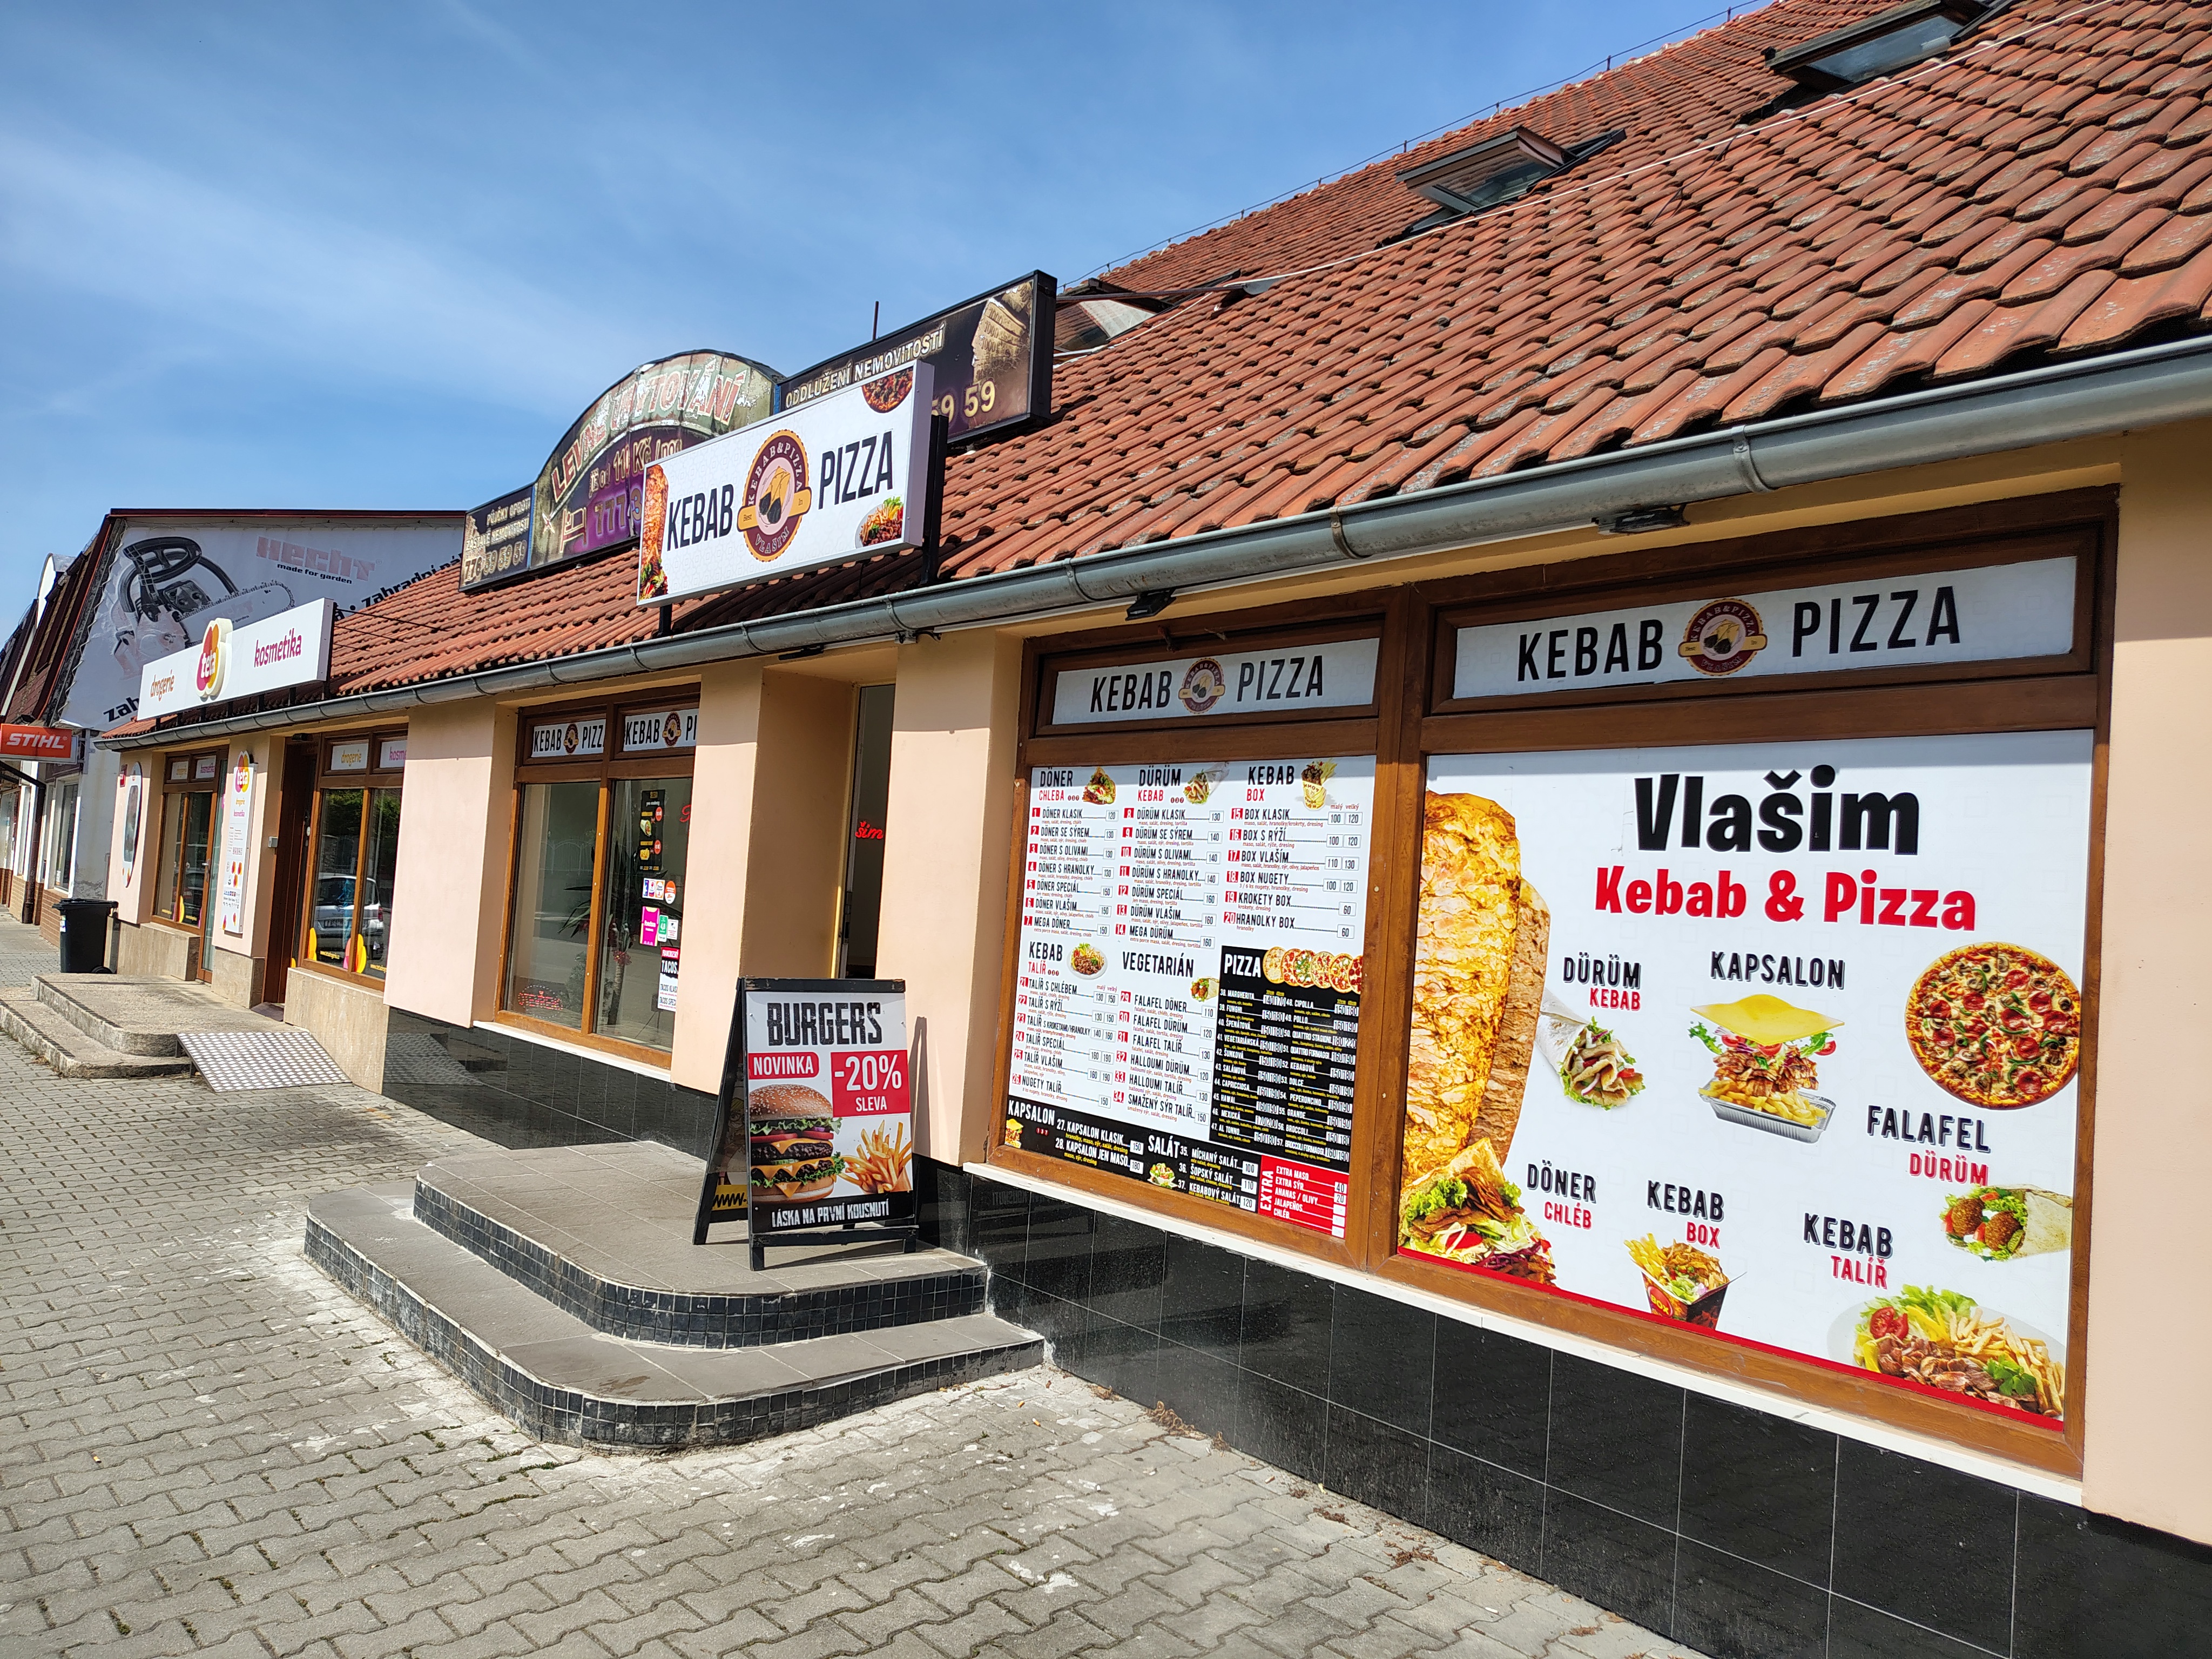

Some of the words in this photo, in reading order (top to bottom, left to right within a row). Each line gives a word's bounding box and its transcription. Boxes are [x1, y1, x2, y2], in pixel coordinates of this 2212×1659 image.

[785, 362, 852, 409] ODDLUŽENÍ
[854, 323, 945, 381] NEMOVITOSTÍ
[965, 381, 996, 417] 59
[667, 484, 733, 551] KEBAB
[819, 431, 893, 510] PIZZA
[755, 525, 789, 554] VLAŠIM
[277, 564, 302, 574] made
[320, 574, 352, 584] garden
[1517, 620, 1663, 682] KEBAB
[1790, 585, 1963, 658] PIZZA
[150, 669, 174, 702] drogerie
[201, 651, 216, 678] teta
[254, 628, 301, 667] kosmetika
[1090, 671, 1172, 712] KEBAB
[1237, 656, 1323, 702] PIZZA
[6, 733, 65, 748] STIHL
[534, 729, 562, 752] KEBAB
[582, 725, 604, 748] PIZZ
[625, 719, 660, 745] KEBAB
[341, 750, 361, 767] drogerie
[237, 769, 248, 785] teta
[1040, 767, 1073, 787] DÖNER
[1139, 765, 1181, 786] DÜRÜM
[1247, 766, 1294, 785] KEBAB
[1039, 790, 1064, 800] CHLEBA
[1138, 790, 1163, 801] KEBAB
[1246, 788, 1265, 801] BOX
[1042, 806, 1060, 819] DÖNER
[1062, 809, 1082, 819] KLASIK
[1245, 809, 1259, 819] BOX
[1263, 809, 1290, 820] KLASIK
[1331, 814, 1340, 823] 100
[1348, 815, 1358, 823] 120
[1634, 764, 1919, 855] Vlašim
[1238, 892, 1273, 905] KROKETY
[1276, 895, 1291, 906] BOX
[1344, 906, 1351, 914] 60
[1595, 866, 1747, 919] Kebab
[1764, 869, 1804, 922] &
[1824, 869, 1976, 930] Pizza
[1034, 917, 1049, 927] MEGA
[1052, 916, 1070, 929] DÖNER
[1131, 903, 1152, 918] DÜRÜM
[1156, 906, 1181, 920] VLAŠIM
[1205, 916, 1213, 925] 160
[1029, 941, 1062, 961] KEBAB
[1028, 960, 1046, 974] TALÍŘ
[1123, 952, 1193, 977] VEGETARIÁN
[1224, 954, 1261, 977] PIZZA
[1563, 953, 1641, 988] DÜRÜM
[1710, 951, 1845, 989] KAPSALON
[1029, 977, 1043, 990] TALÍŘ
[1046, 981, 1049, 991] S
[1051, 981, 1077, 995] CHLÉBEM
[1228, 990, 1255, 1000] MARGHERITA
[1135, 995, 1162, 1009] FALAFEL
[1165, 997, 1186, 1013] DÖNER
[1205, 1008, 1213, 1017] 110
[1589, 988, 1641, 1011] KEBAB
[767, 1002, 882, 1046] BURGERS
[753, 1056, 813, 1076] NOVINKA
[834, 1055, 902, 1091] -20%
[855, 1096, 887, 1111] SLEVA
[1128, 1094, 1158, 1110] SMAŽENÝ
[1160, 1098, 1172, 1114] SÝR
[1175, 1103, 1192, 1117] TALÍŘ
[1198, 1114, 1206, 1122] 150
[1290, 1094, 1321, 1105] PEPERONCINO
[1008, 1100, 1055, 1125] KAPSALON
[1162, 1114, 1177, 1122] dressing
[1287, 1109, 1306, 1118] GRANDE
[1057, 1119, 1065, 1131] 27.
[1067, 1122, 1100, 1139] KAPSALON
[1101, 1129, 1124, 1145] KLASIK
[1866, 1105, 1991, 1153] FALAFEL
[1055, 1138, 1064, 1149] 28.
[1067, 1141, 1097, 1158] KAPSALON
[1098, 1150, 1108, 1161] JEN
[1148, 1135, 1180, 1158] SALÁT
[1180, 1146, 1188, 1156] 35.
[1192, 1148, 1217, 1163] MÍCHANÝ
[1219, 1155, 1238, 1169] SALÁT
[1246, 1164, 1254, 1173] 100
[1909, 1151, 1988, 1187] DÜRÜM
[1276, 1166, 1292, 1177] EXTRA
[1294, 1170, 1309, 1181] MASO
[1528, 1161, 1596, 1204] DÖNER
[1260, 1171, 1273, 1211] EXTRA
[1648, 1179, 1725, 1222] KEBAB
[772, 1210, 800, 1228] LÁSKA
[802, 1208, 815, 1223] NA
[817, 1203, 845, 1221] PRVNÍ
[847, 1199, 889, 1219] KOUSNUTÍ
[1273, 1208, 1290, 1219] CHLÉB
[1274, 1198, 1303, 1212] JALAPEÑOS
[1543, 1201, 1593, 1230] CHLÉB
[1685, 1221, 1721, 1249] BOX
[1803, 1213, 1893, 1258] KEBAB
[1831, 1255, 1888, 1289] TALÍŘ
[1651, 1294, 1669, 1315] BOX
